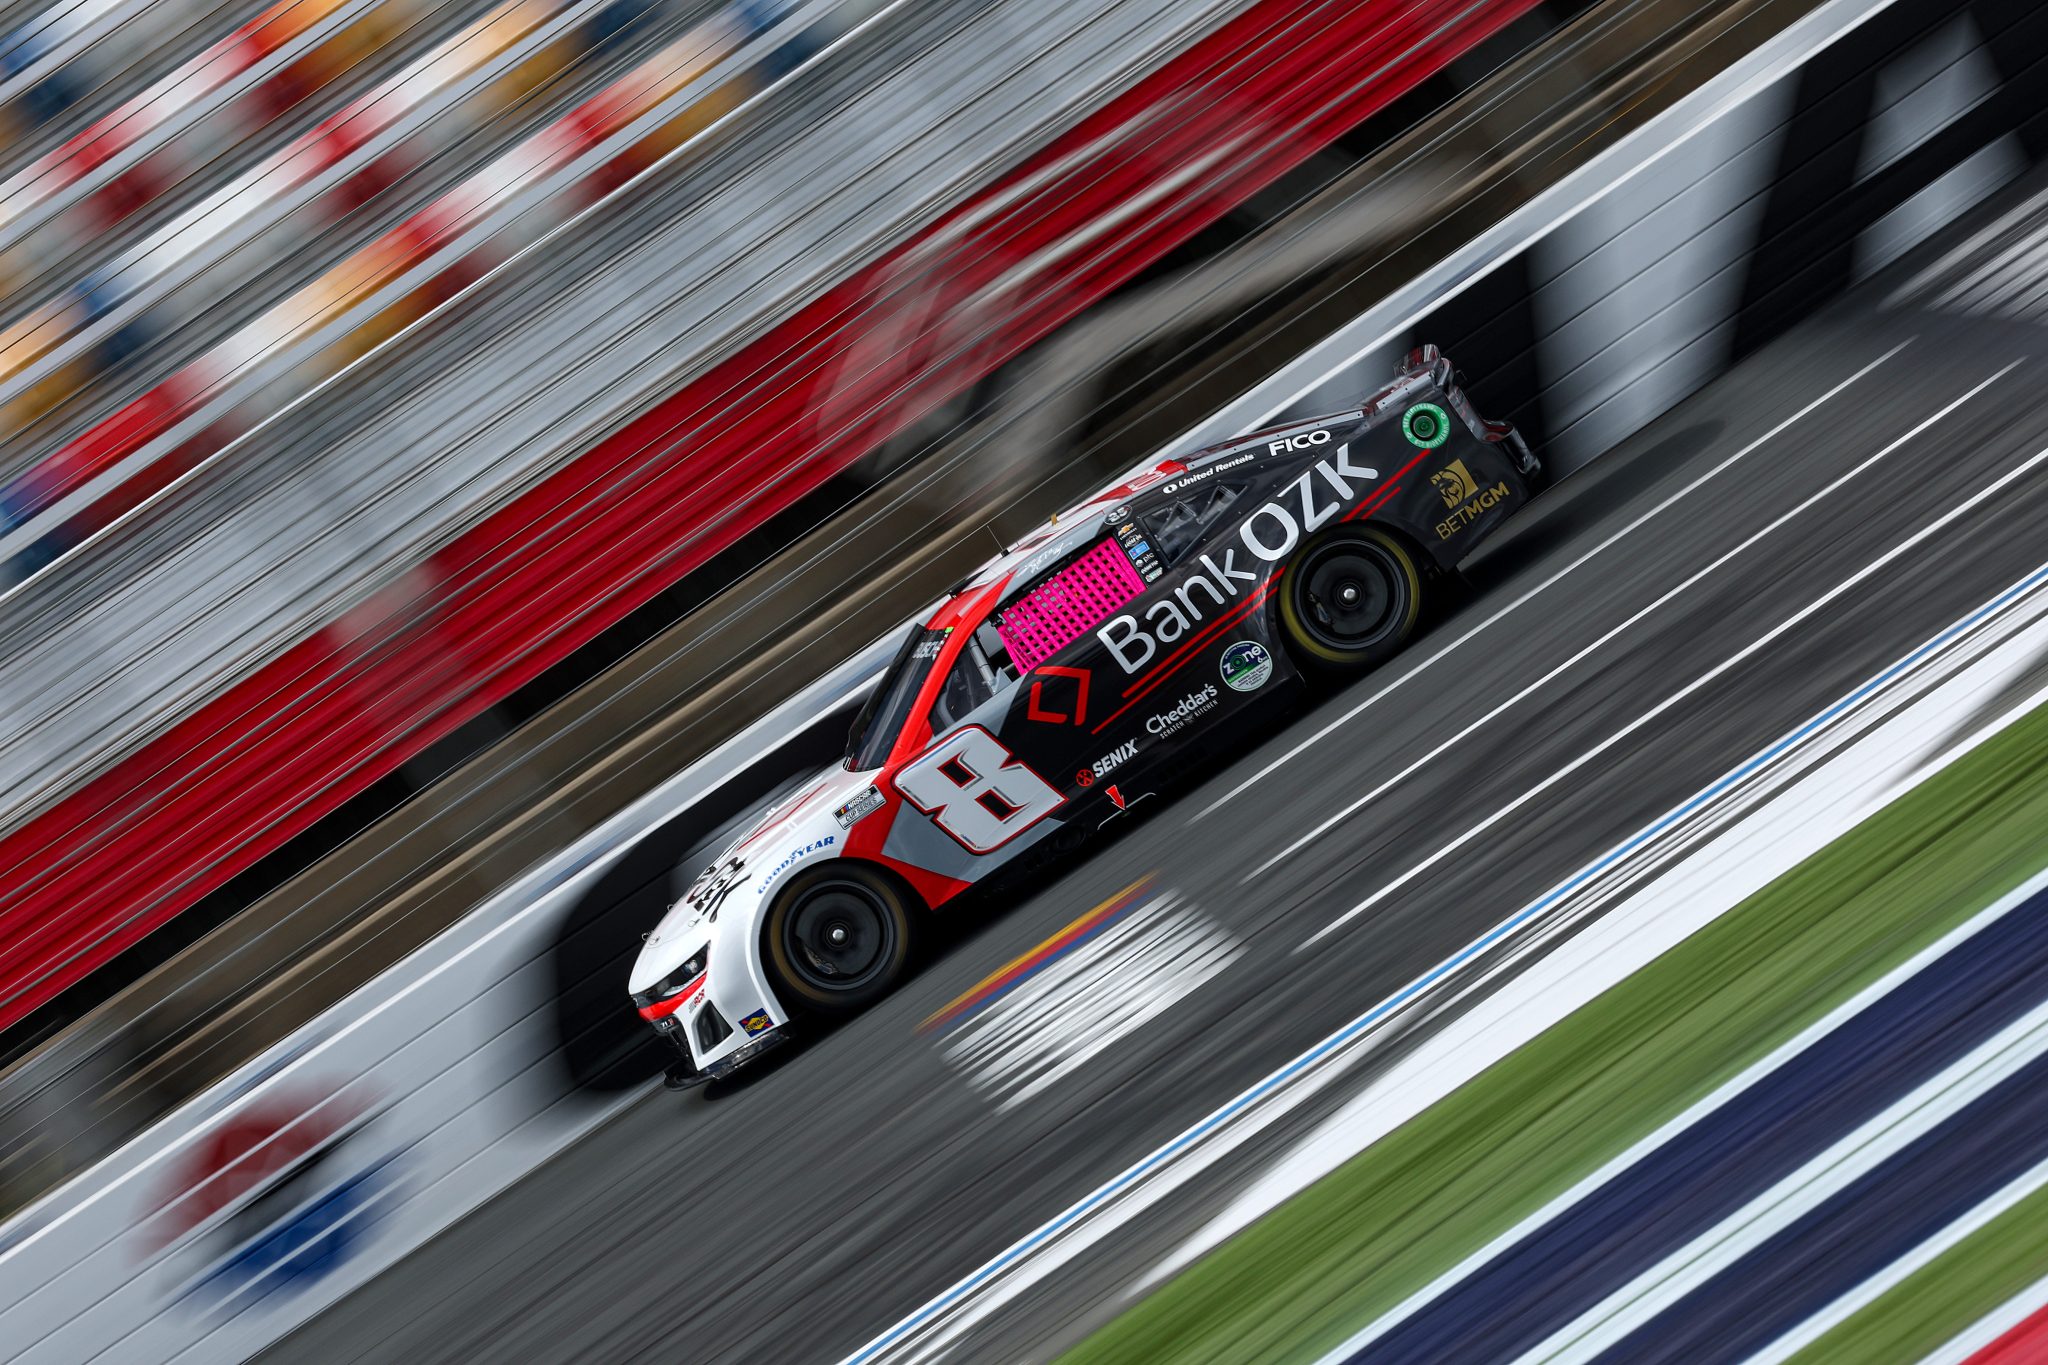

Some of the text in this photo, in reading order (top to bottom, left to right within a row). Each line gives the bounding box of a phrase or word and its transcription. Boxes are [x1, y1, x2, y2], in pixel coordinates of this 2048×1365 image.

[1268, 429, 1331, 458] FICO
[1178, 453, 1255, 488] United Rentals
[1435, 481, 1510, 541] BETMGM
[1096, 443, 1379, 675] Bank OZK
[1223, 645, 1262, 675] zone
[1146, 683, 1218, 735] Cheddar's
[1159, 699, 1219, 740] SCRATCH KITCHEN
[1092, 738, 1139, 779] SENIX
[891, 723, 1069, 856] 8
[757, 835, 836, 895] GOODYEAR
[744, 1014, 770, 1033] SUNOCO
